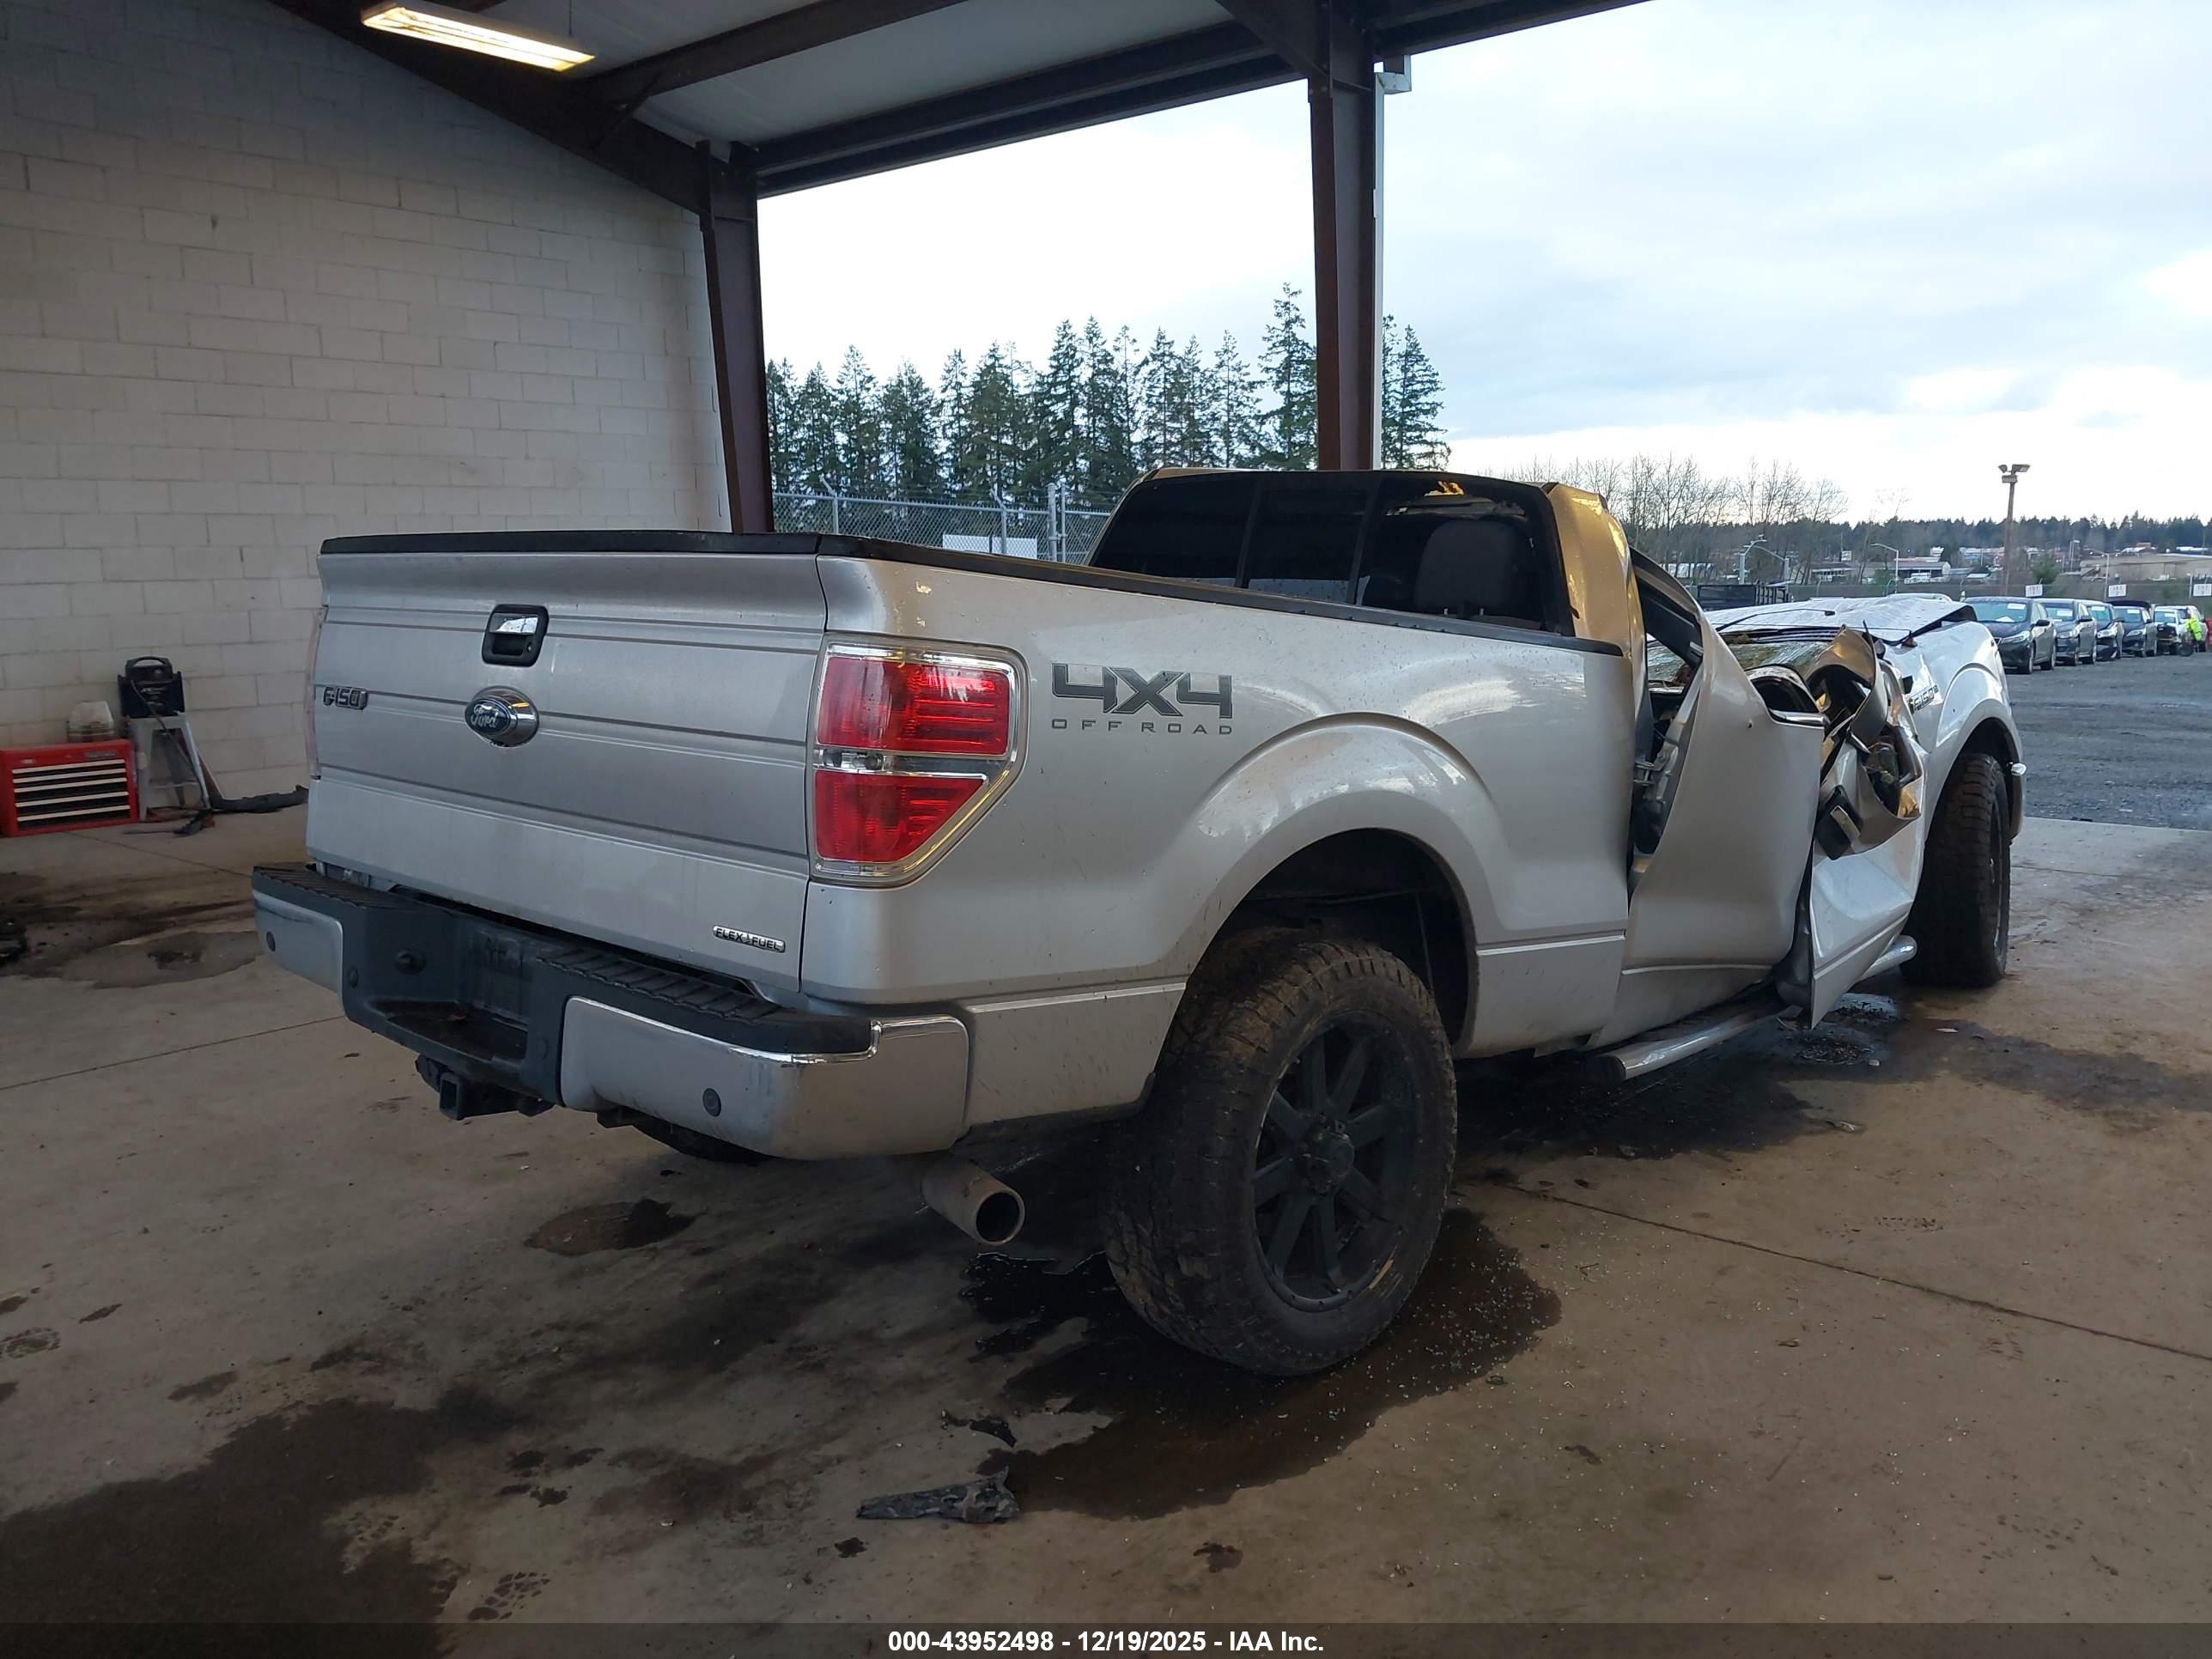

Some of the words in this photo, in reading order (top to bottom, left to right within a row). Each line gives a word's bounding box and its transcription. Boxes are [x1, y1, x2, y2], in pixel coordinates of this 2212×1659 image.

[324, 686, 365, 709] F-150
[1052, 663, 1232, 719] 4X4
[715, 927, 744, 943] FLEX
[751, 936, 780, 951] FUEL
